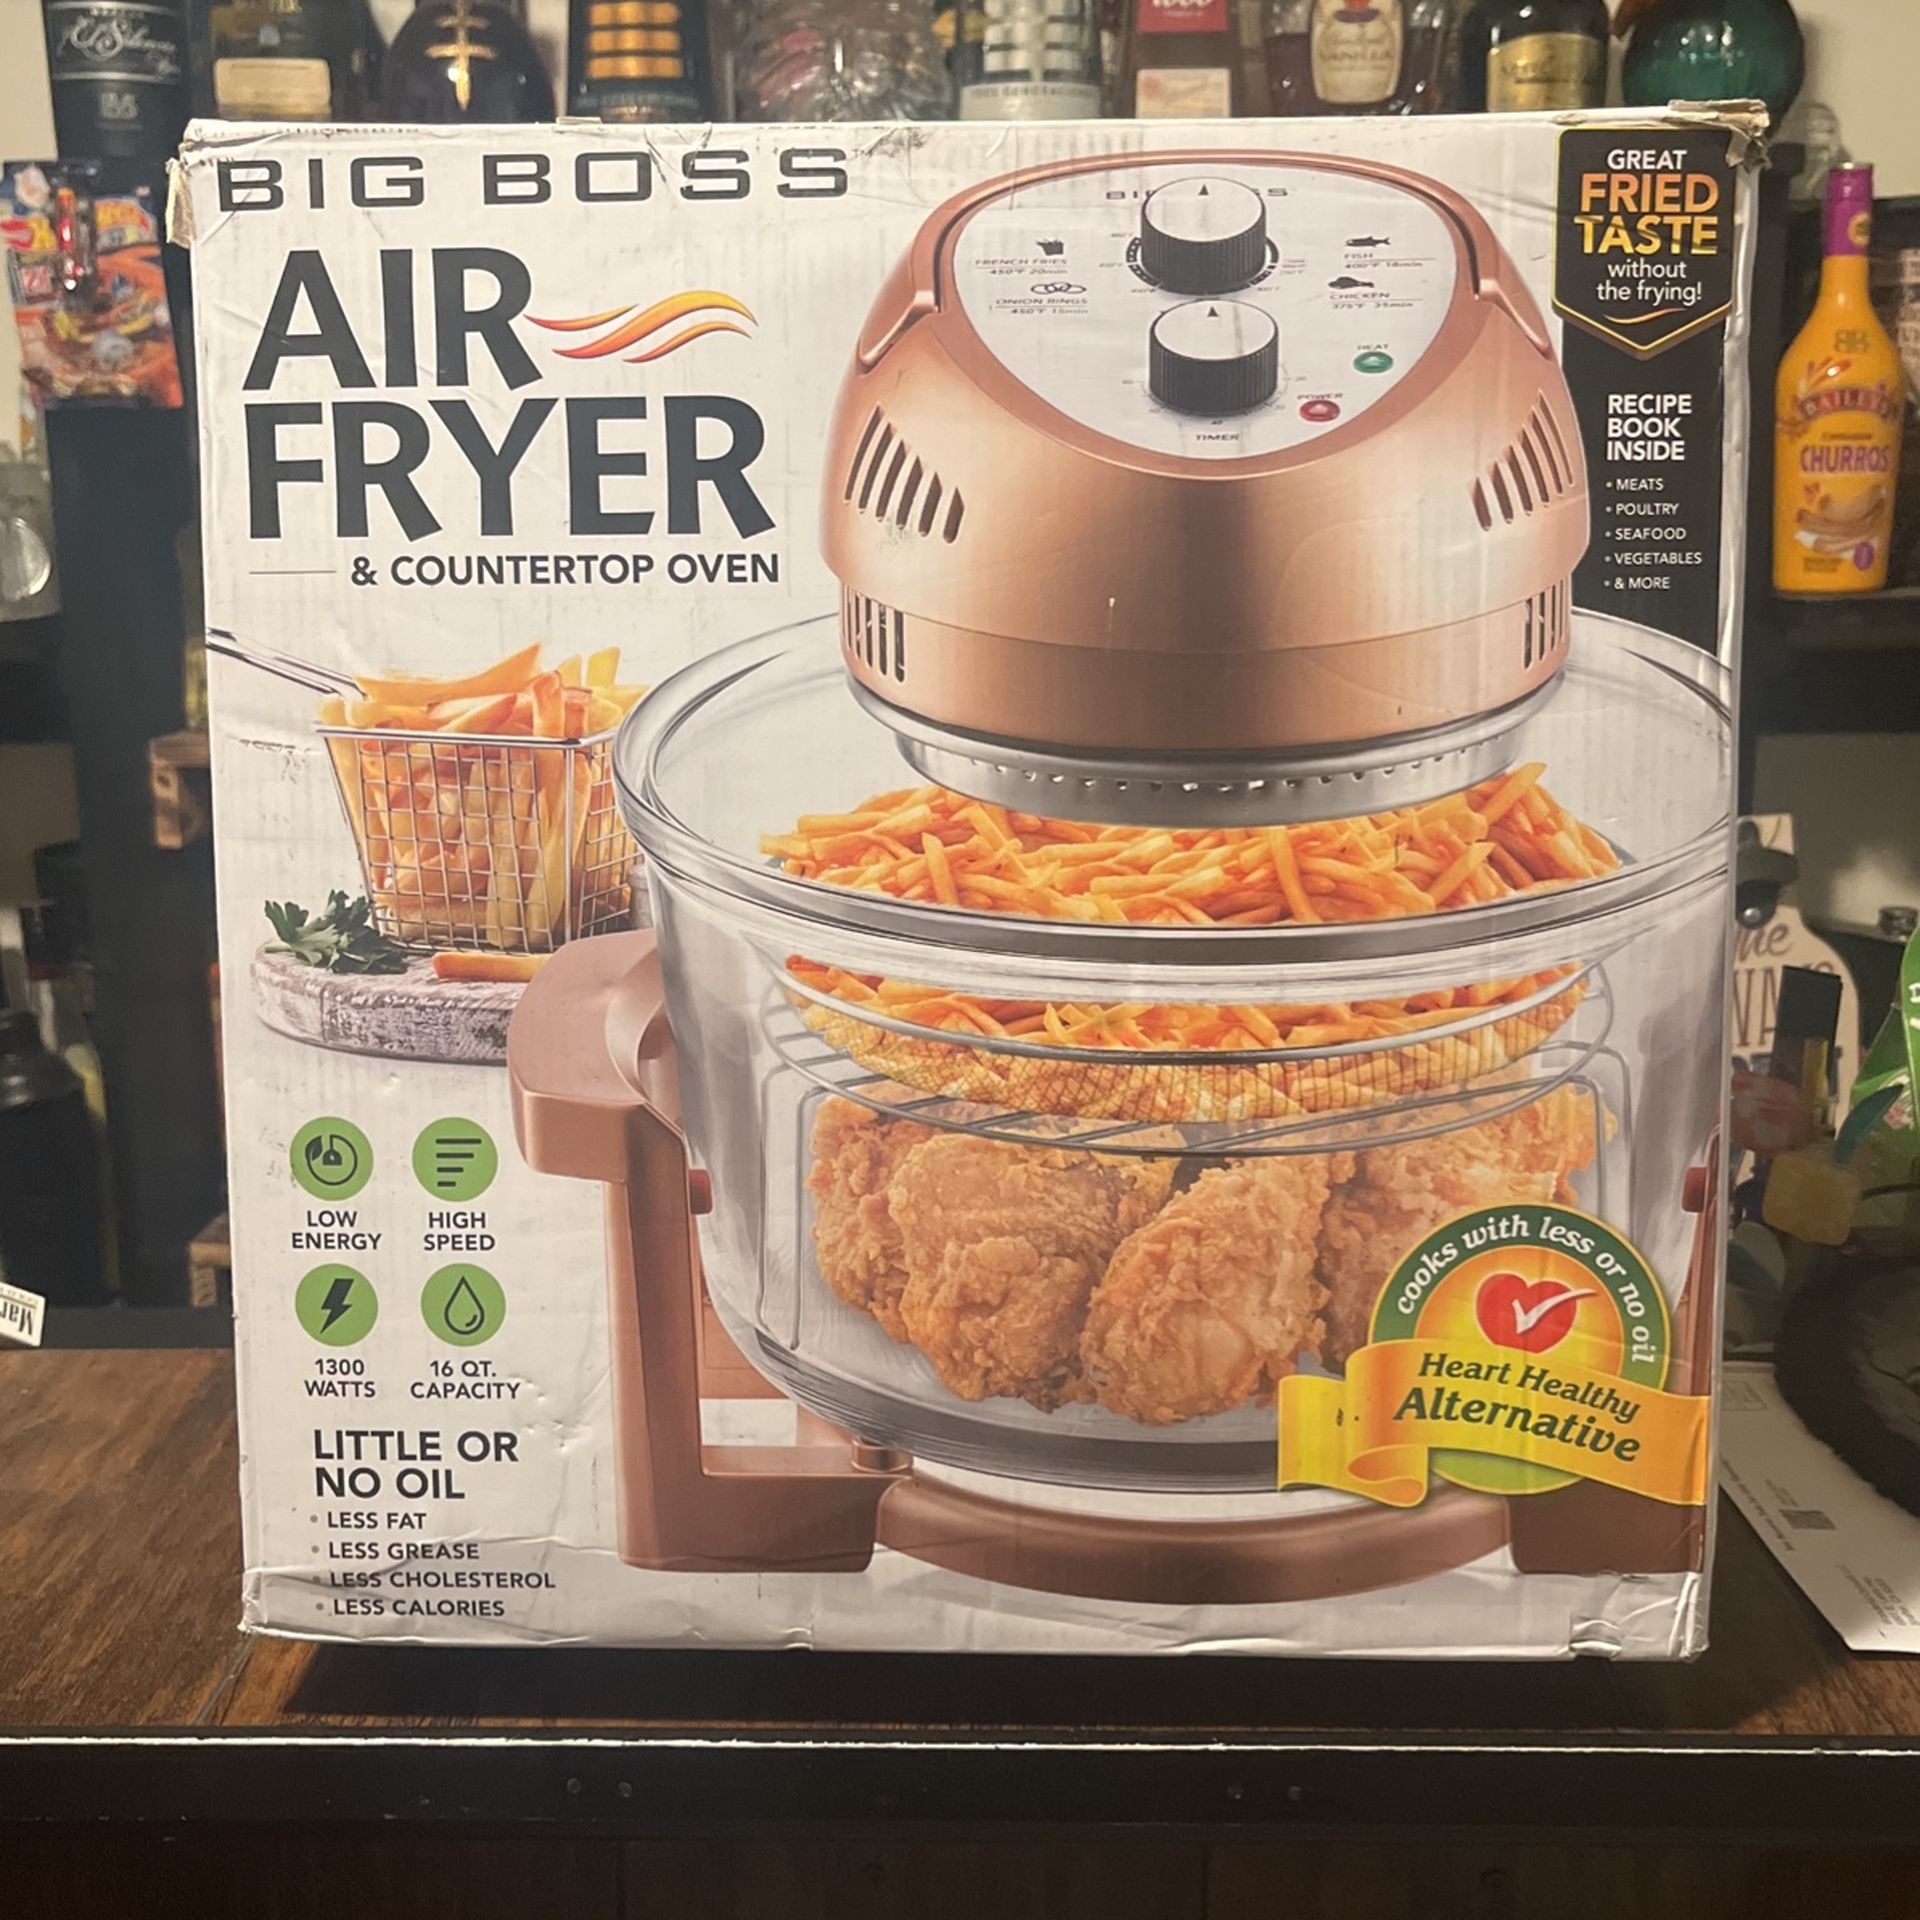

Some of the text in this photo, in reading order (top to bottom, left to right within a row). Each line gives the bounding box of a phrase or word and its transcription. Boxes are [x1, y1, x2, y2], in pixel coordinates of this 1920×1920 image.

[1607, 149, 1687, 170] GREAT
[217, 147, 848, 212] BIG BOSS
[1581, 173, 1719, 213] FRIED
[1574, 215, 1718, 255] TASTE
[975, 257, 1067, 266] FRENCH FRIES
[1344, 252, 1373, 260] FISH
[990, 267, 1025, 275] 450°F
[1608, 258, 1687, 278] without
[996, 297, 1042, 305] ONION
[1329, 292, 1390, 300] CHICKEN
[1597, 281, 1702, 306] the frying!
[242, 246, 543, 391] AIR
[1010, 307, 1046, 315] 450°F
[1608, 394, 1693, 414] RECIPE
[1607, 417, 1681, 438] BOOK
[1606, 441, 1686, 461] INSIDE
[1801, 445, 1888, 473] CHURROS
[244, 394, 777, 541] FRYER
[1616, 478, 1664, 491] MEATS
[1615, 503, 1679, 516] POULTRY
[1615, 527, 1686, 540] SEAFOOD
[1614, 552, 1703, 565] VEGETABLES
[352, 553, 779, 586] & COUNTERTOP OVEN
[1614, 576, 1670, 589] & MORE
[307, 1211, 357, 1228] LOW
[429, 1212, 486, 1229] HIGH
[292, 1233, 381, 1250] ENERGY
[424, 1234, 495, 1250] SPEED
[1397, 1214, 1656, 1363] cooks with less or no oil
[315, 1359, 364, 1375] 1300
[430, 1361, 496, 1377] 16 QT.
[304, 1380, 376, 1397] WATTS
[411, 1382, 520, 1399] CAPACITY
[1418, 1352, 1641, 1424] Heart Healthy
[1393, 1386, 1641, 1462] Alternative
[314, 1430, 518, 1462] LITTLE OR
[316, 1467, 465, 1499] NO OIL
[327, 1512, 426, 1529] LESS FAT
[329, 1542, 479, 1559] LESS GREASE
[330, 1572, 556, 1588] LESS CHOLESTEROL
[334, 1599, 505, 1616] LESS CALORIES
